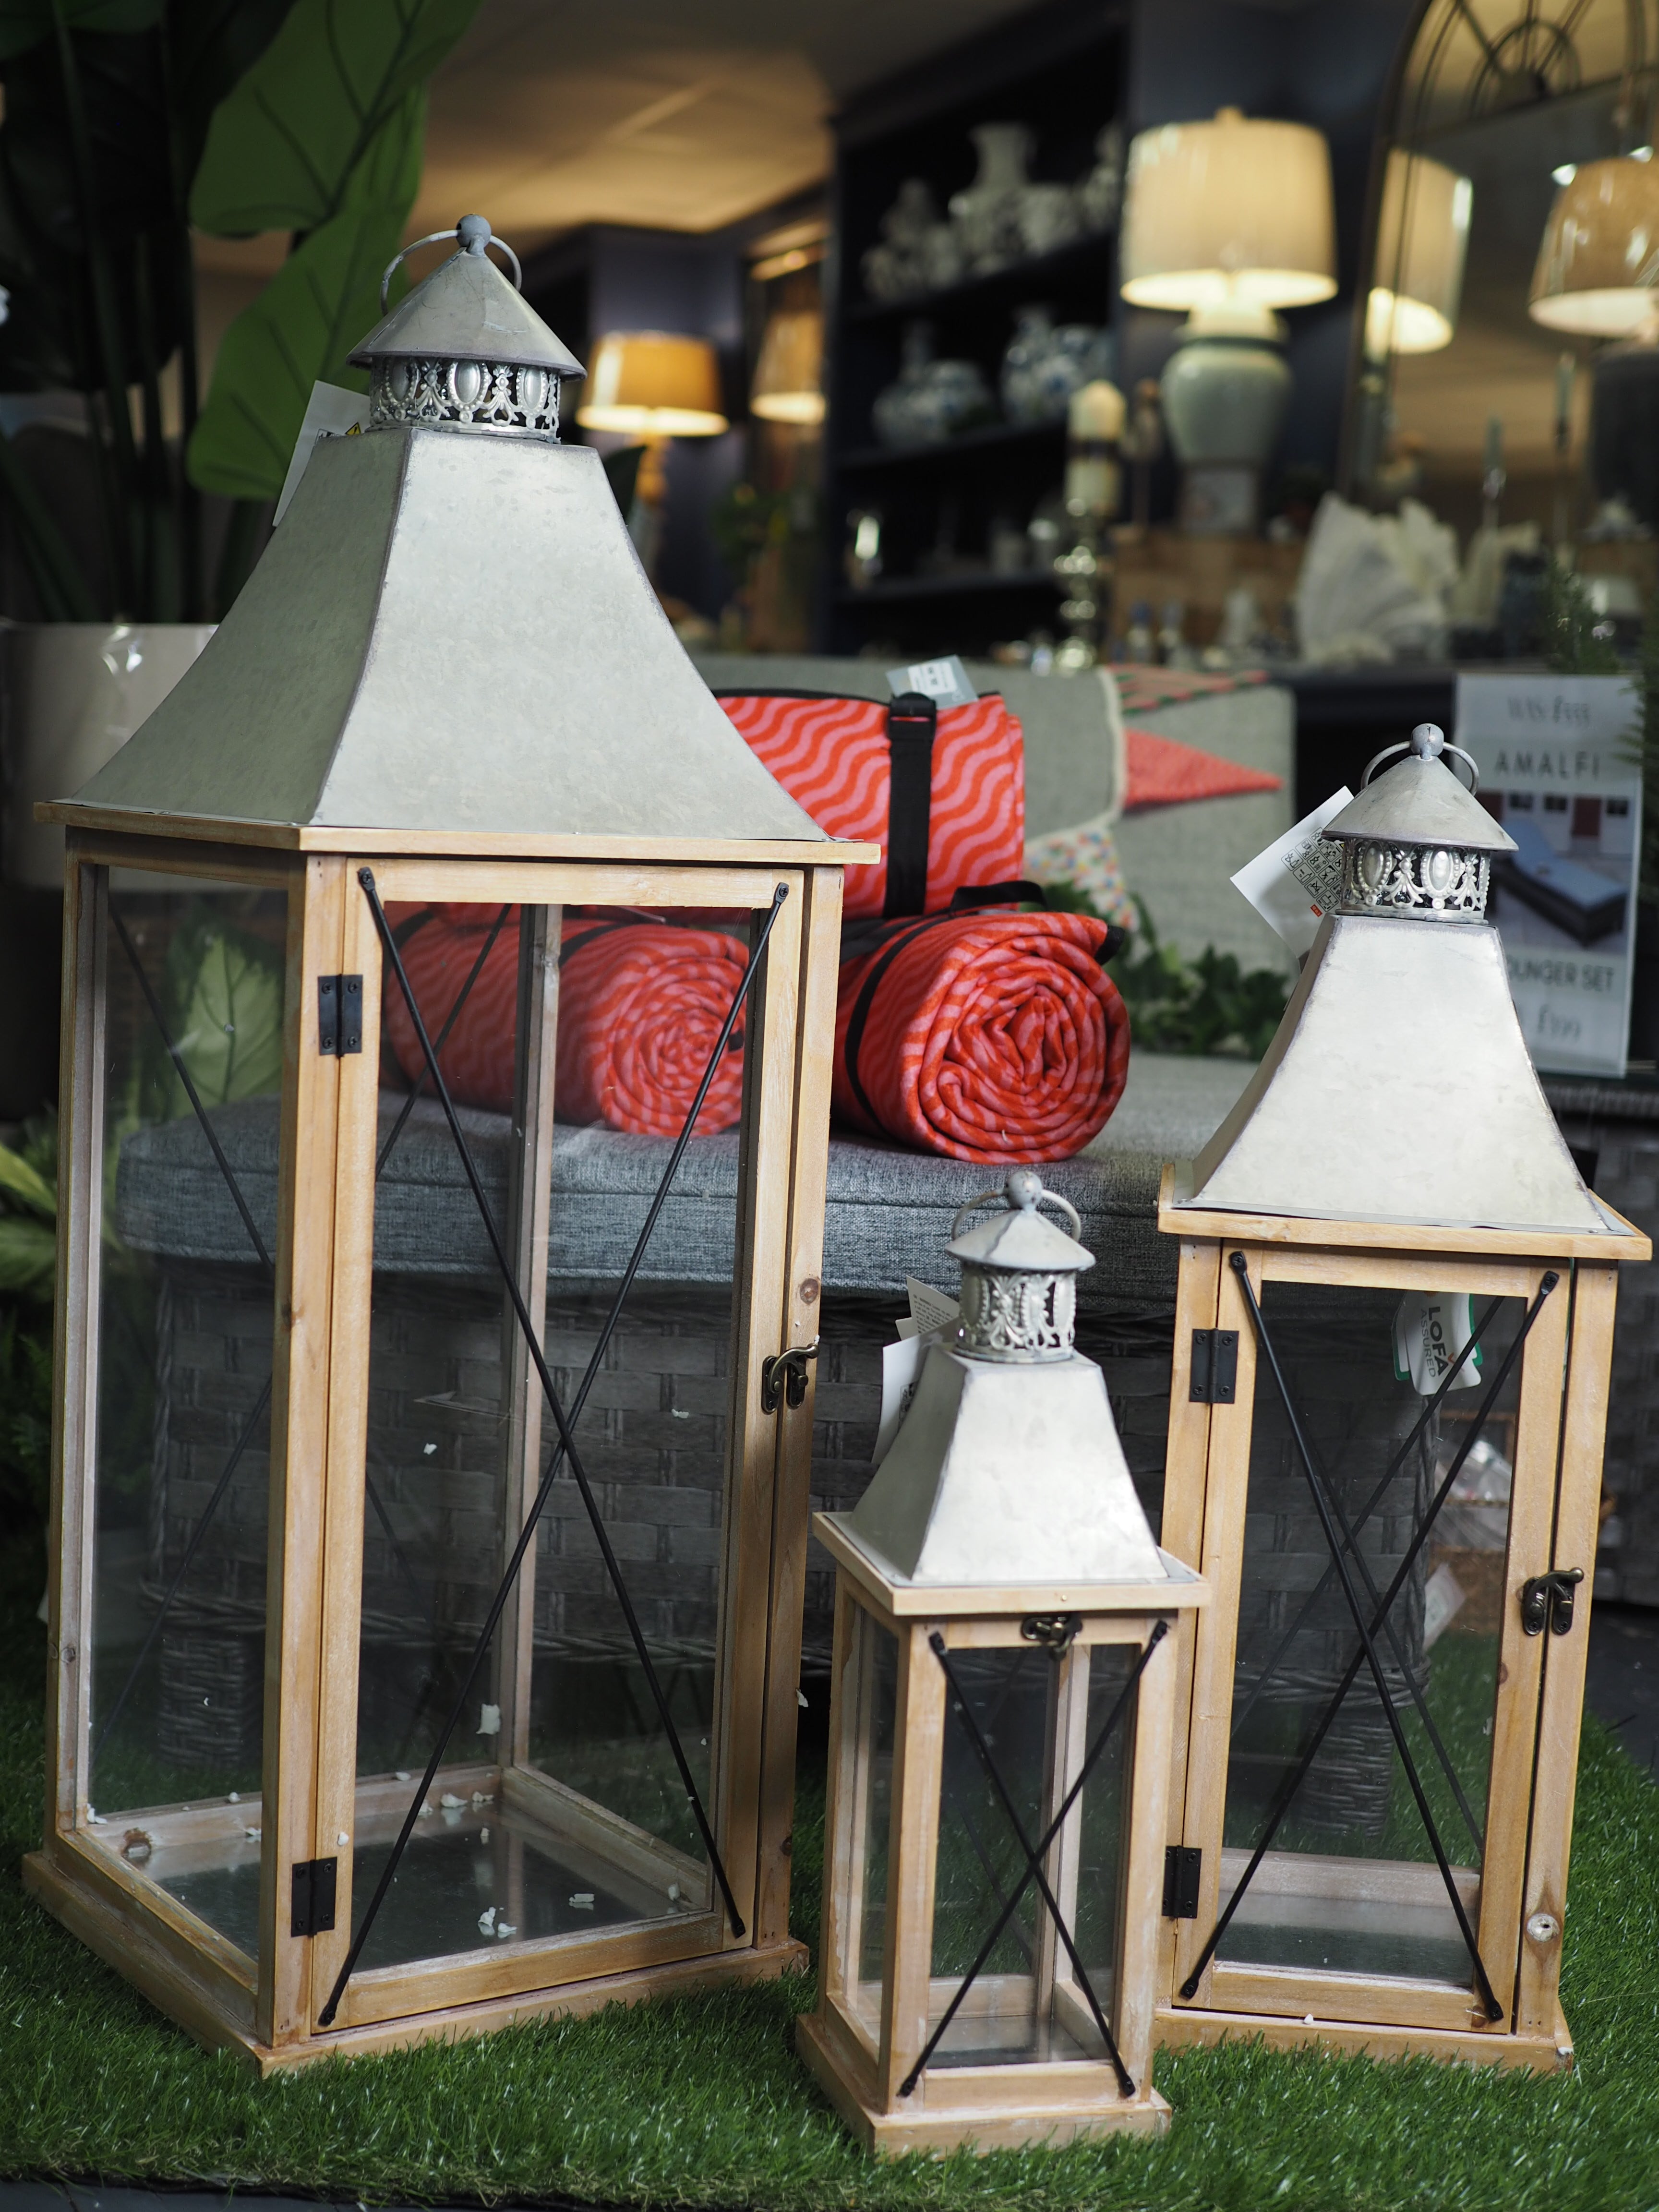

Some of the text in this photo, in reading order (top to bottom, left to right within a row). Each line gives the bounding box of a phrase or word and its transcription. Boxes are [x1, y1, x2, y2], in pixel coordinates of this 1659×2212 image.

[1495, 749, 1600, 780] AMALFI
[1582, 963, 1614, 992] SET
[1420, 1309, 1436, 1378] ASSURED
[1429, 1306, 1449, 1376] LOFA
